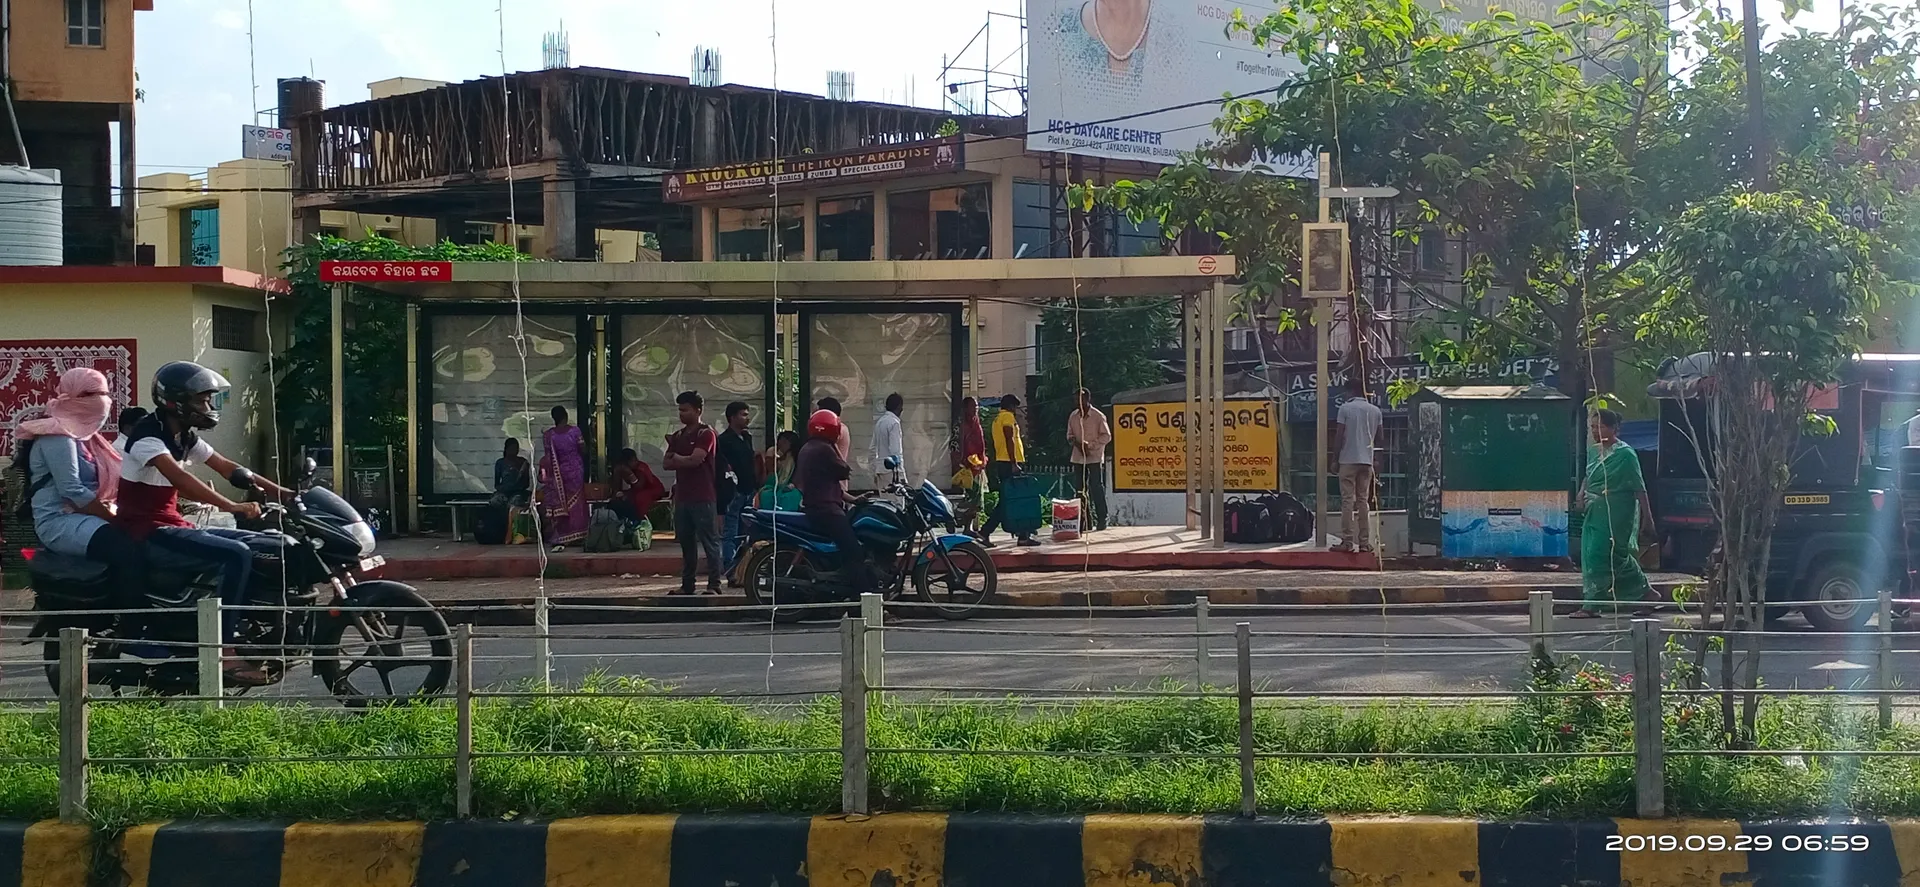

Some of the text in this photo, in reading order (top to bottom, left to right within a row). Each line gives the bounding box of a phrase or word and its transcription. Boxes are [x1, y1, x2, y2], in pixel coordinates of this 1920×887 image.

[1196, 5, 1214, 18] HCG
[1236, 61, 1287, 78] #TogetherToWin
[1048, 119, 1162, 146] HCG DAYCARE CENTER
[1047, 135, 1060, 145] Plot
[1105, 143, 1132, 154] JAYADEV
[685, 159, 785, 184] KNOCKOUT
[818, 155, 853, 169] IRON
[858, 147, 931, 165] PARADISE
[810, 170, 833, 178] ZUMBA
[843, 165, 872, 174] SPECIAL
[872, 161, 903, 171] CLASSES
[332, 263, 440, 277] ଜୟଦେବ ବିହାର ଛକ
[1118, 406, 1148, 434] ଶକ୍ତି
[1149, 436, 1171, 444] GSTIN
[1138, 445, 1164, 454] PHONE
